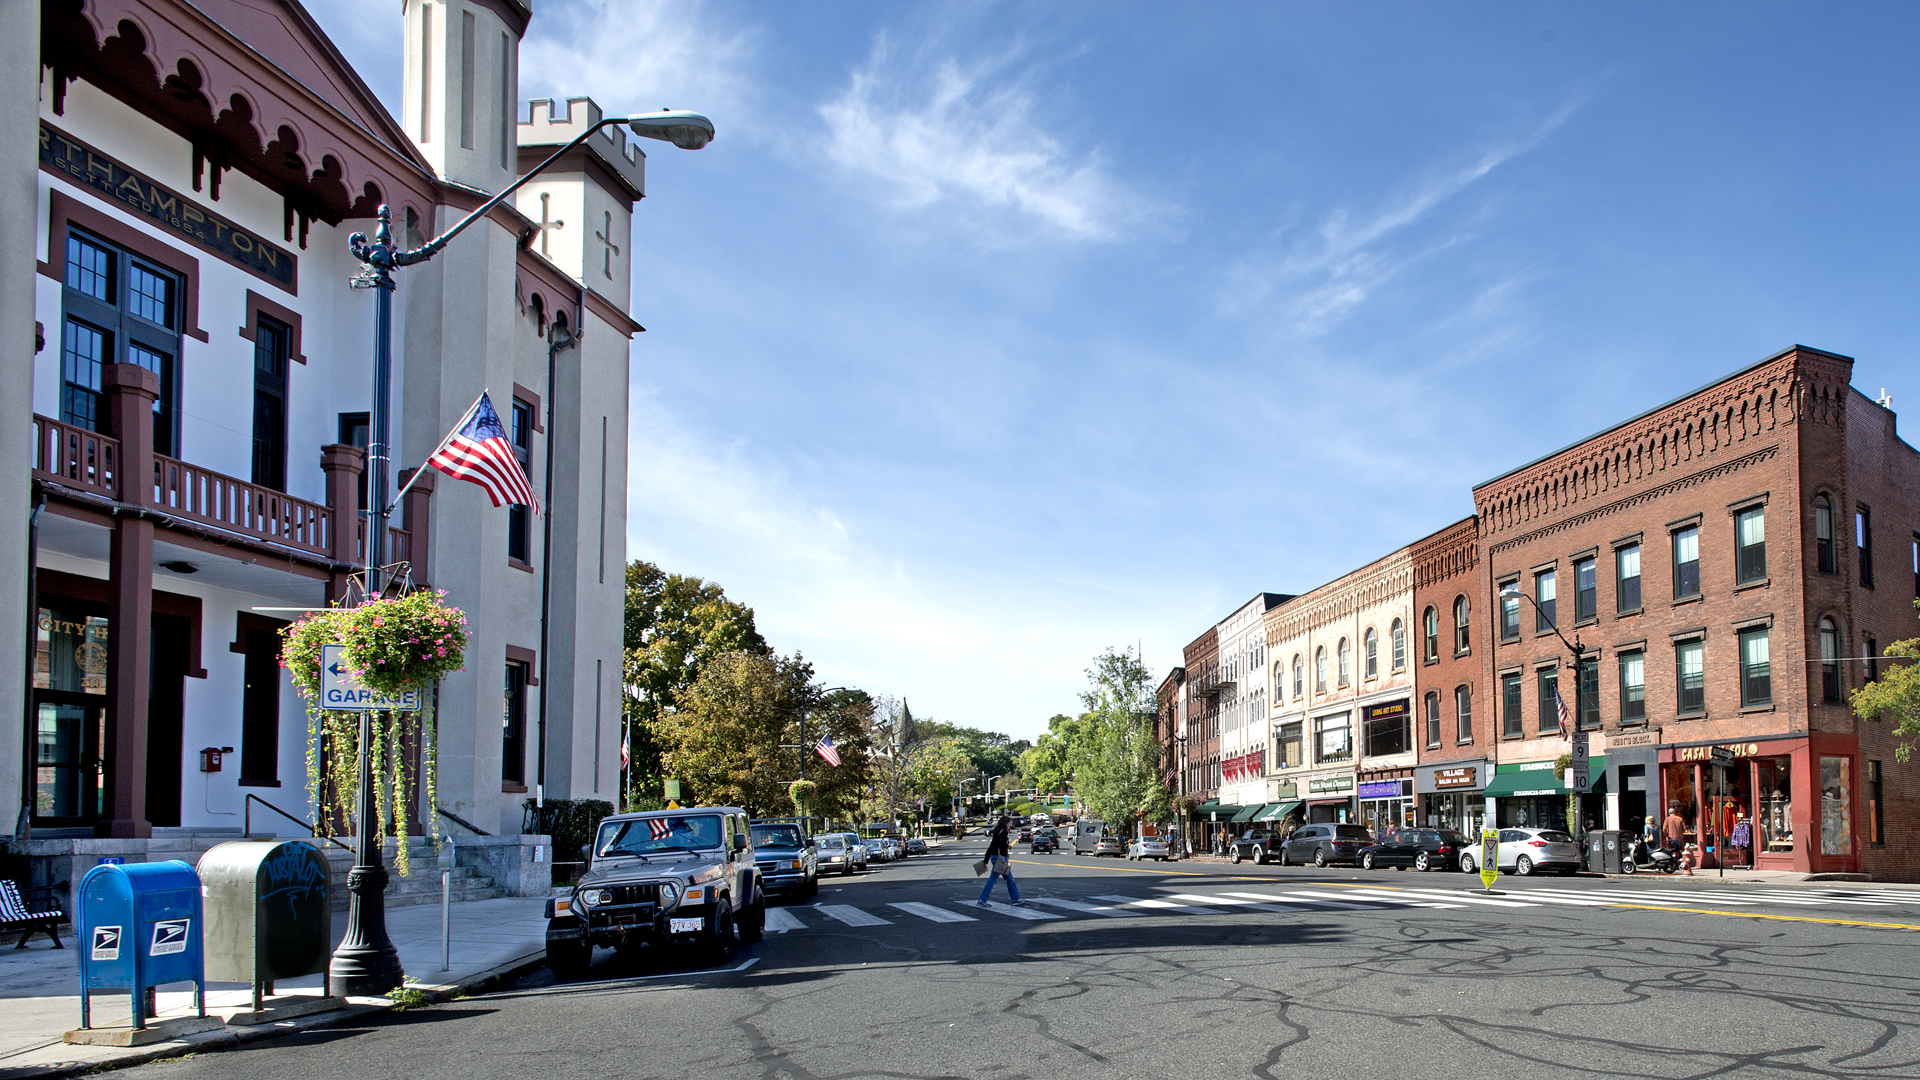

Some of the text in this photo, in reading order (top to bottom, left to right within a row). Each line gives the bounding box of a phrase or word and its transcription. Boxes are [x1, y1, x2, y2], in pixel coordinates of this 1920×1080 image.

[54, 157, 204, 239] SETTLED 1654
[39, 618, 87, 636] CITY
[1390, 705, 1402, 713] STUDIO
[1577, 746, 1584, 758] 9
[1682, 747, 1705, 760] CASA
[1520, 761, 1555, 772] STARBUCKS
[1443, 769, 1465, 777] VILLAGE
[1320, 781, 1332, 789] Street
[1575, 776, 1587, 788] 10
